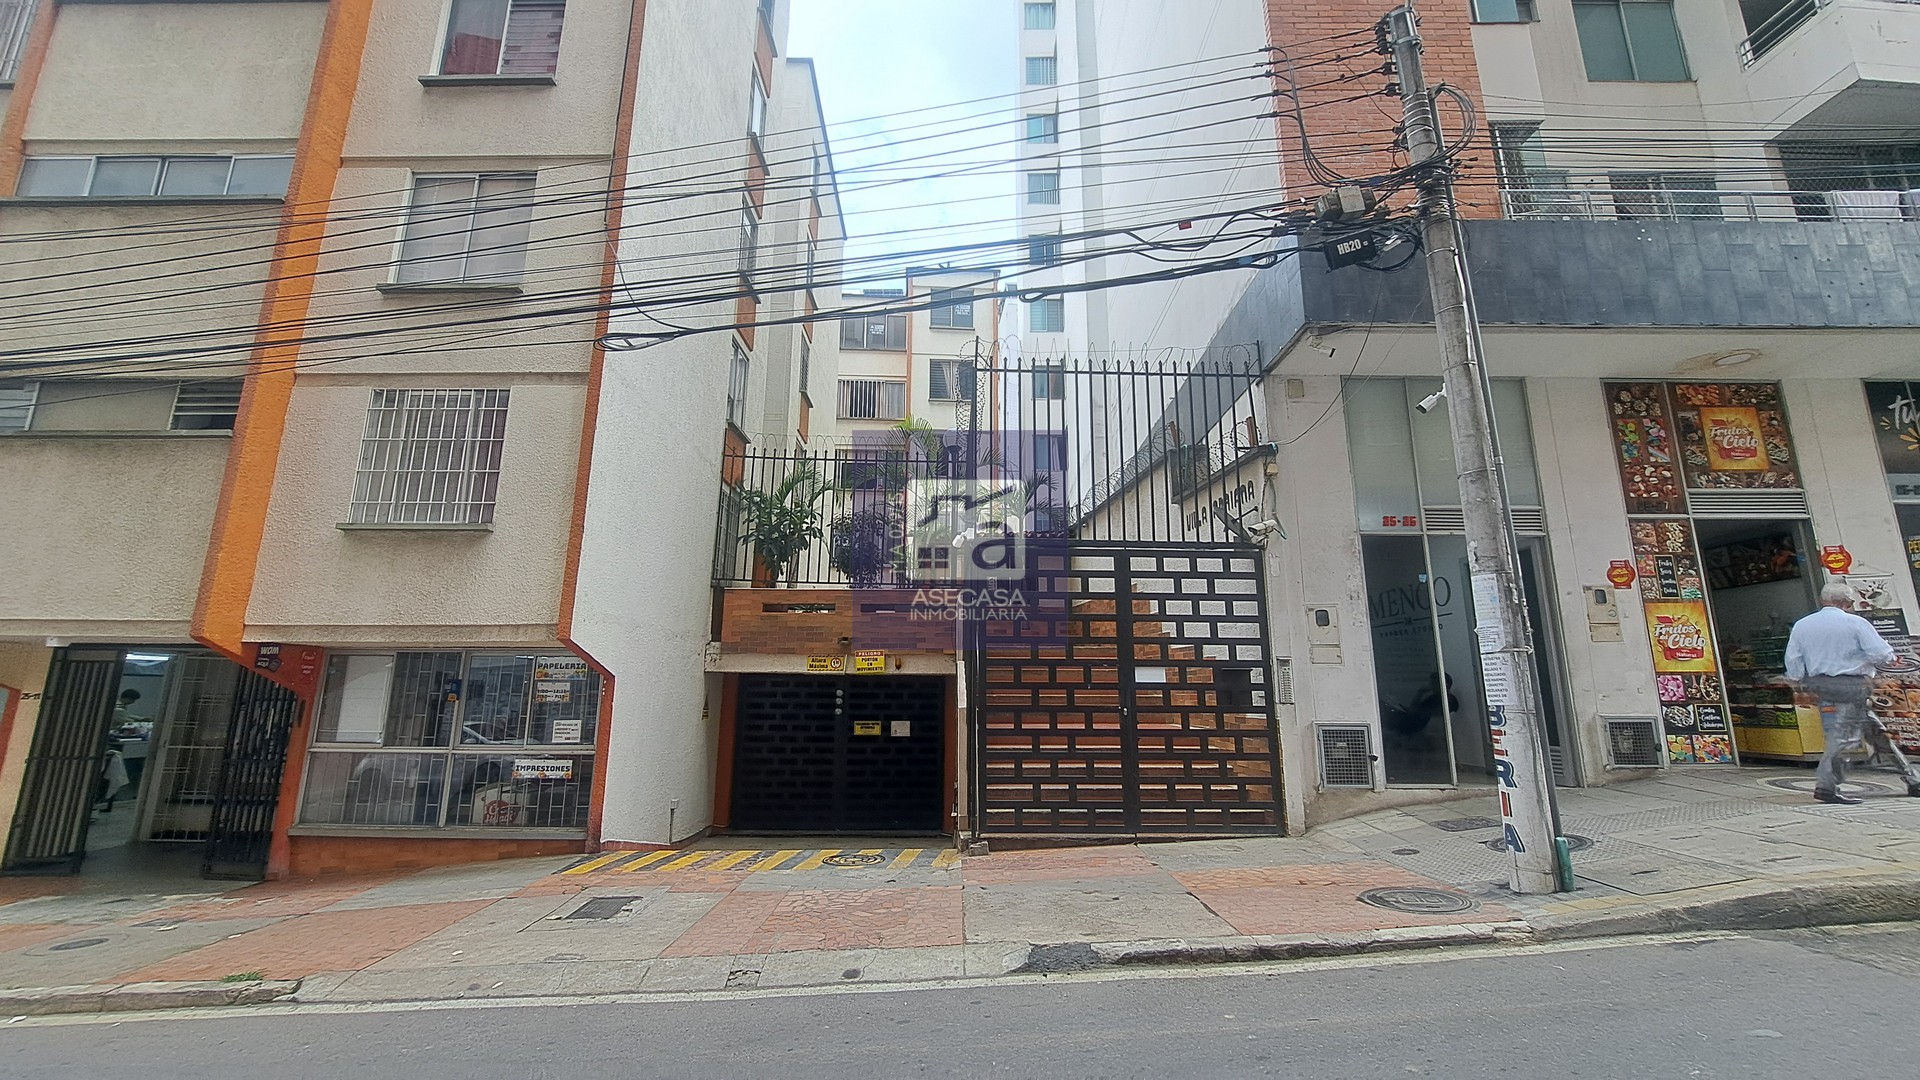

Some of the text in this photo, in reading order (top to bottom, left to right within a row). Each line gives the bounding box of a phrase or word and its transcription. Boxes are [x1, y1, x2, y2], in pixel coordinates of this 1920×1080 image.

[1723, 435, 1758, 448] Cielo
[1653, 624, 1696, 637] Frutos
[1668, 633, 1706, 649] Cielo
[261, 646, 279, 655] WOM
[537, 662, 587, 670] PAPELERIA
